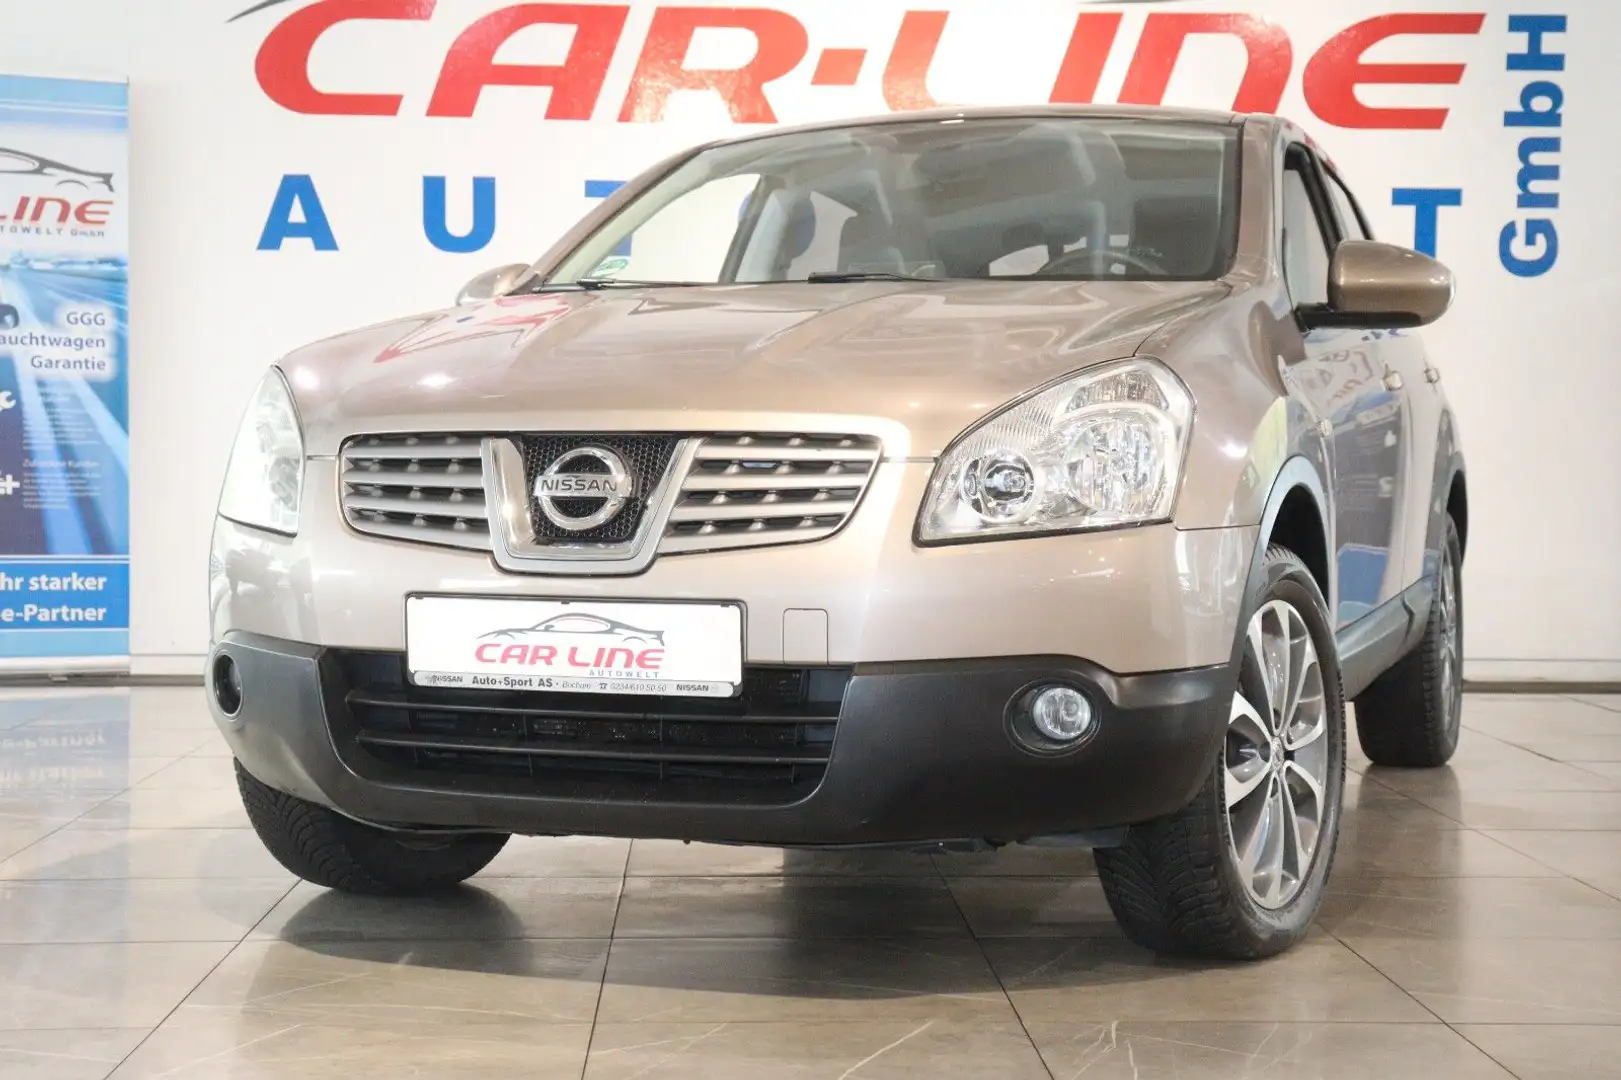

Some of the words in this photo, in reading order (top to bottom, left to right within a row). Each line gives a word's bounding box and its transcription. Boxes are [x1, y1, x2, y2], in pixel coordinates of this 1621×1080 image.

[1499, 14, 1567, 278] GmbH
[0, 196, 114, 225] INE
[66, 312, 106, 326] GGG
[31, 355, 106, 371] Garantie
[541, 479, 618, 492] NISSAN
[29, 571, 107, 591] starker
[0, 603, 107, 622] e-Partner
[474, 643, 557, 667] CAR
[567, 645, 665, 669] LINE
[589, 670, 660, 678] AUTOWELT
[472, 675, 533, 687] Auto+Sport
[538, 678, 553, 688] AS
[676, 684, 709, 692] NISSAN
